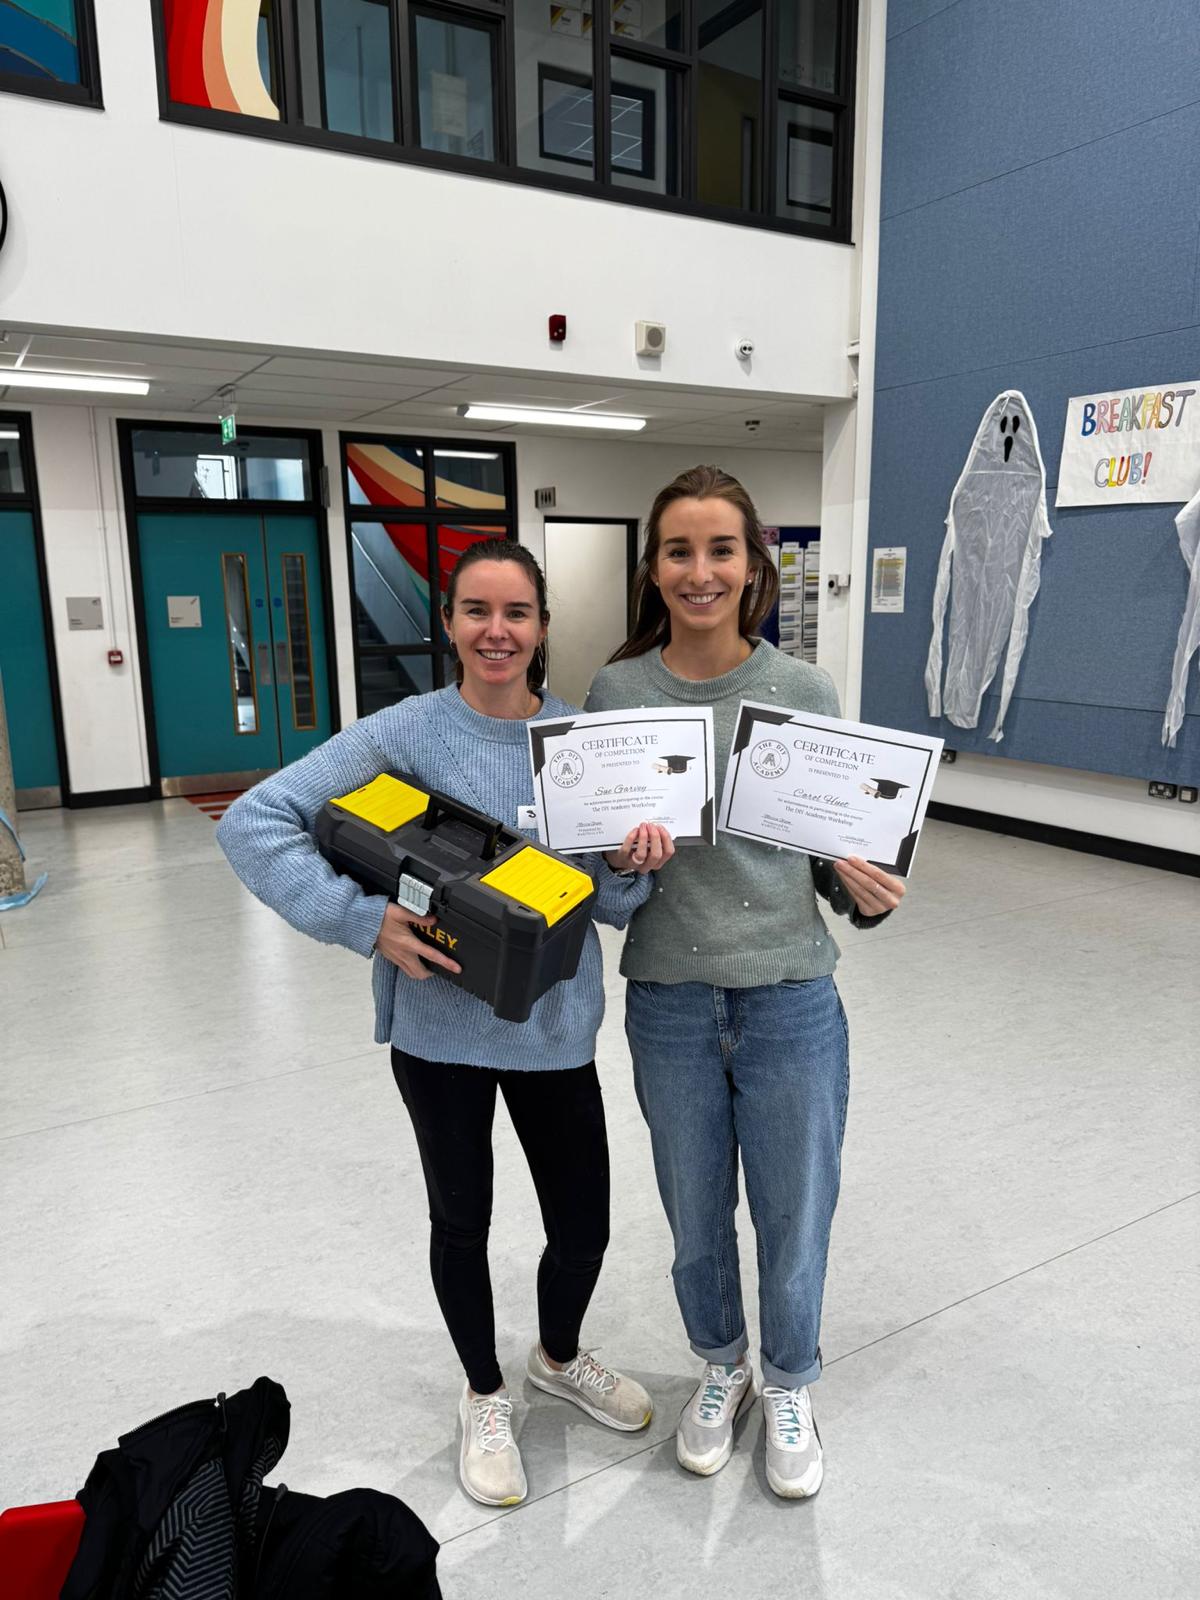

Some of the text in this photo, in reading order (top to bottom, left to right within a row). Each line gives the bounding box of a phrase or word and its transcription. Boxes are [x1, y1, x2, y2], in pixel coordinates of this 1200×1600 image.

[1081, 390, 1196, 437] BREAKFAST
[1095, 452, 1153, 488] CLUB!
[582, 735, 659, 751] CERTIFICATE
[758, 742, 786, 755] THE DIY
[554, 752, 579, 763] THE DIY
[604, 748, 646, 757] COMPLETION
[794, 740, 876, 765] CERTIFICATE
[753, 761, 784, 776] ACADEMY
[815, 757, 860, 771] COMPLETION
[554, 773, 581, 786] ACADEMY
[814, 769, 841, 779] PRESENTED
[595, 786, 612, 797] Sue
[795, 807, 804, 815] DIY
[805, 812, 827, 821] Academy
[828, 816, 853, 827] Workshop
